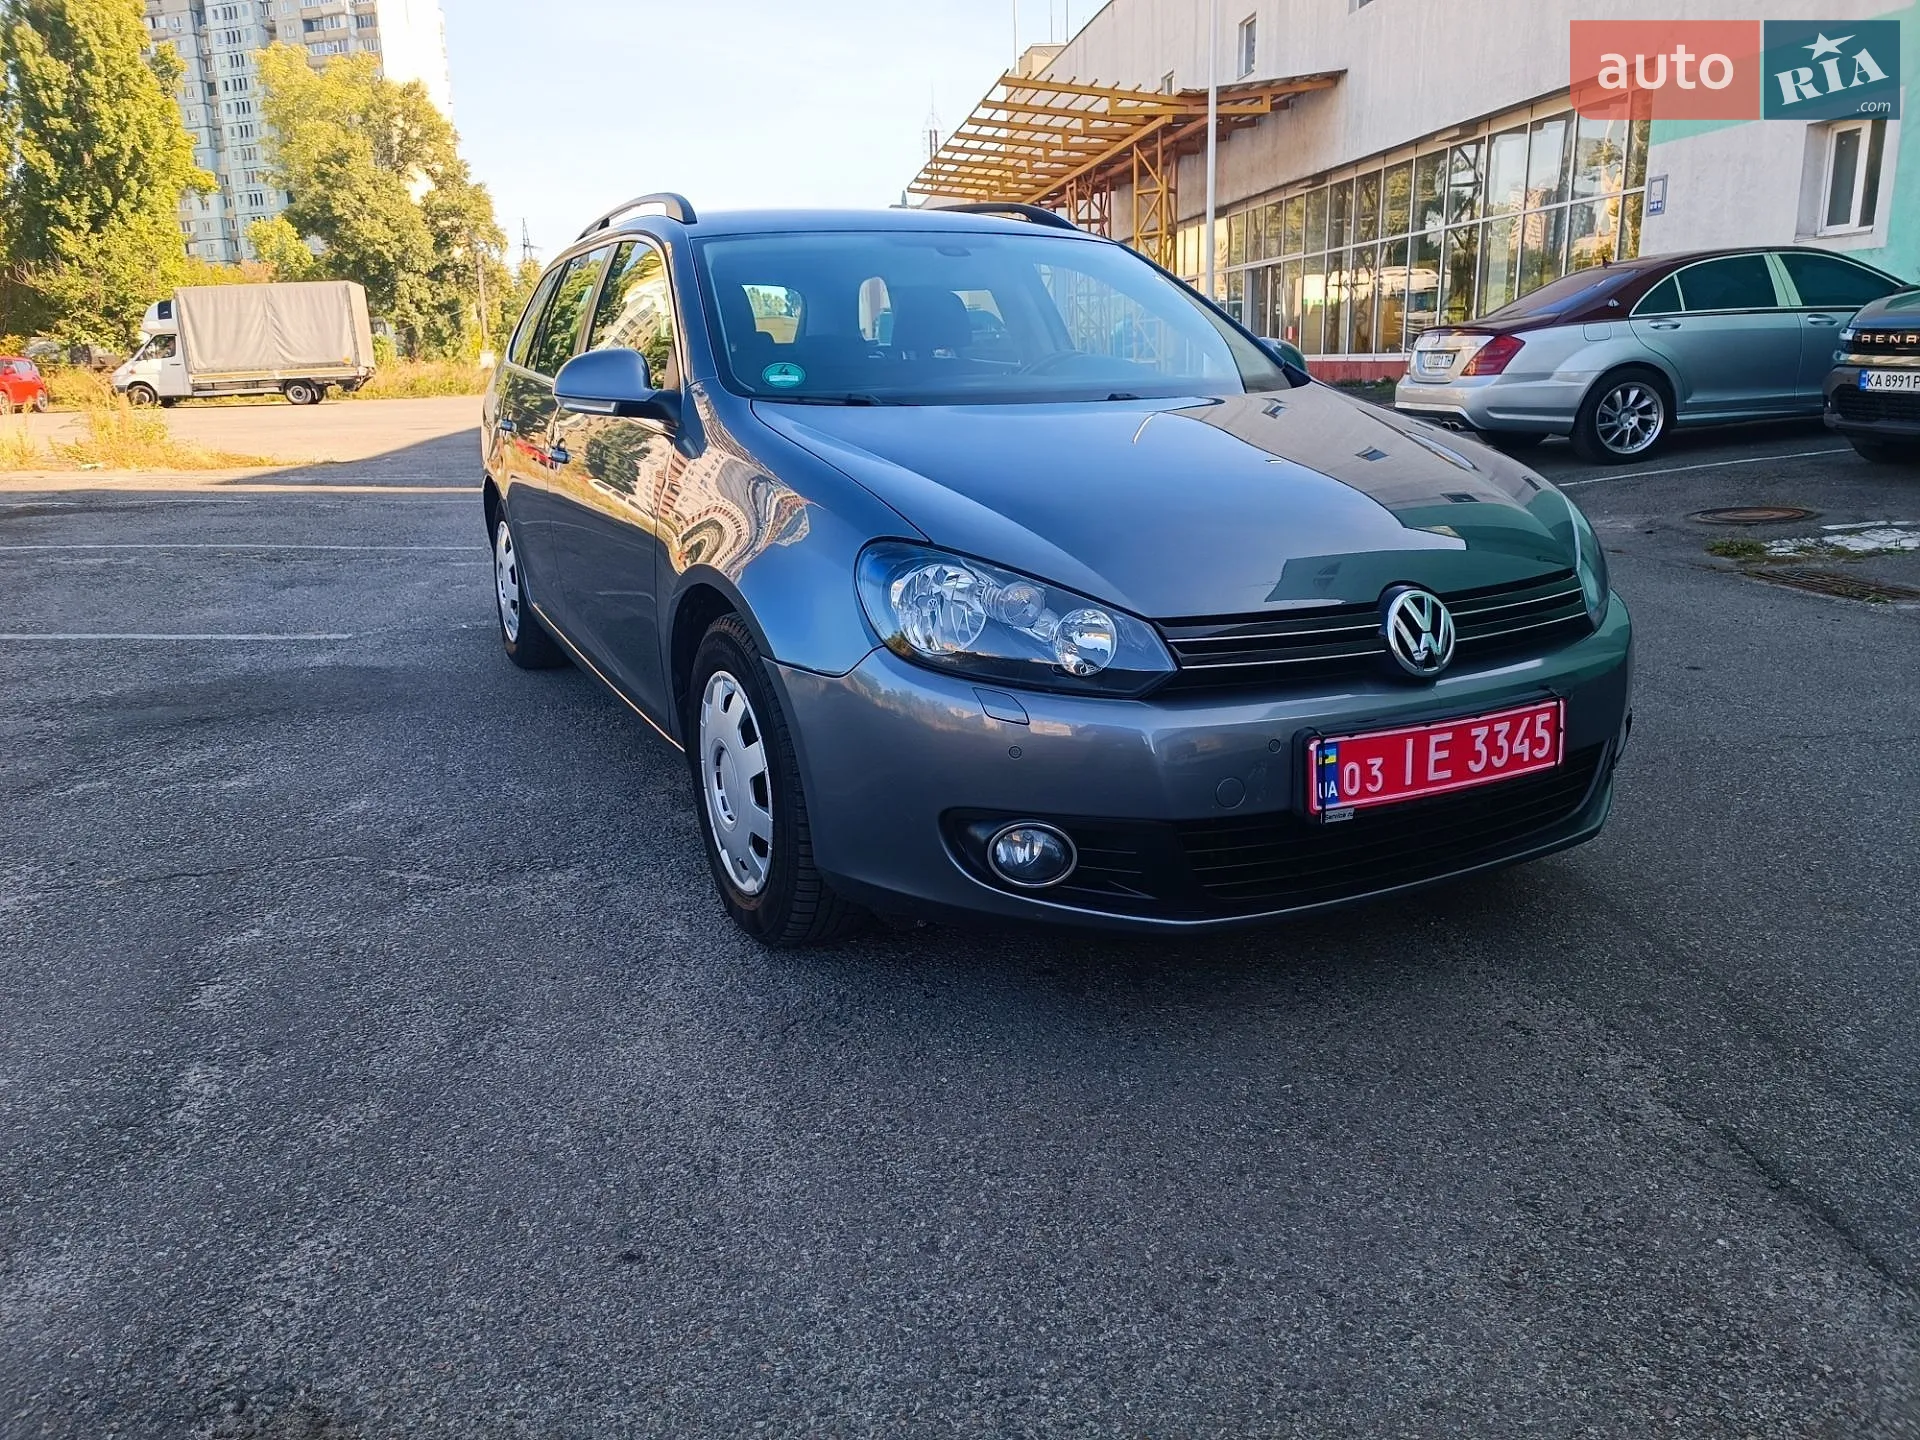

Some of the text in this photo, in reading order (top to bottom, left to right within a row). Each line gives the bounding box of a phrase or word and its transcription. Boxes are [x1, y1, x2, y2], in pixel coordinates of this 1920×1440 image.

[1866, 374, 1882, 387] KA
[1885, 374, 1911, 388] 8991
[1344, 757, 1384, 795] 03
[1468, 712, 1550, 773] 3345
[1318, 780, 1338, 799] UA
